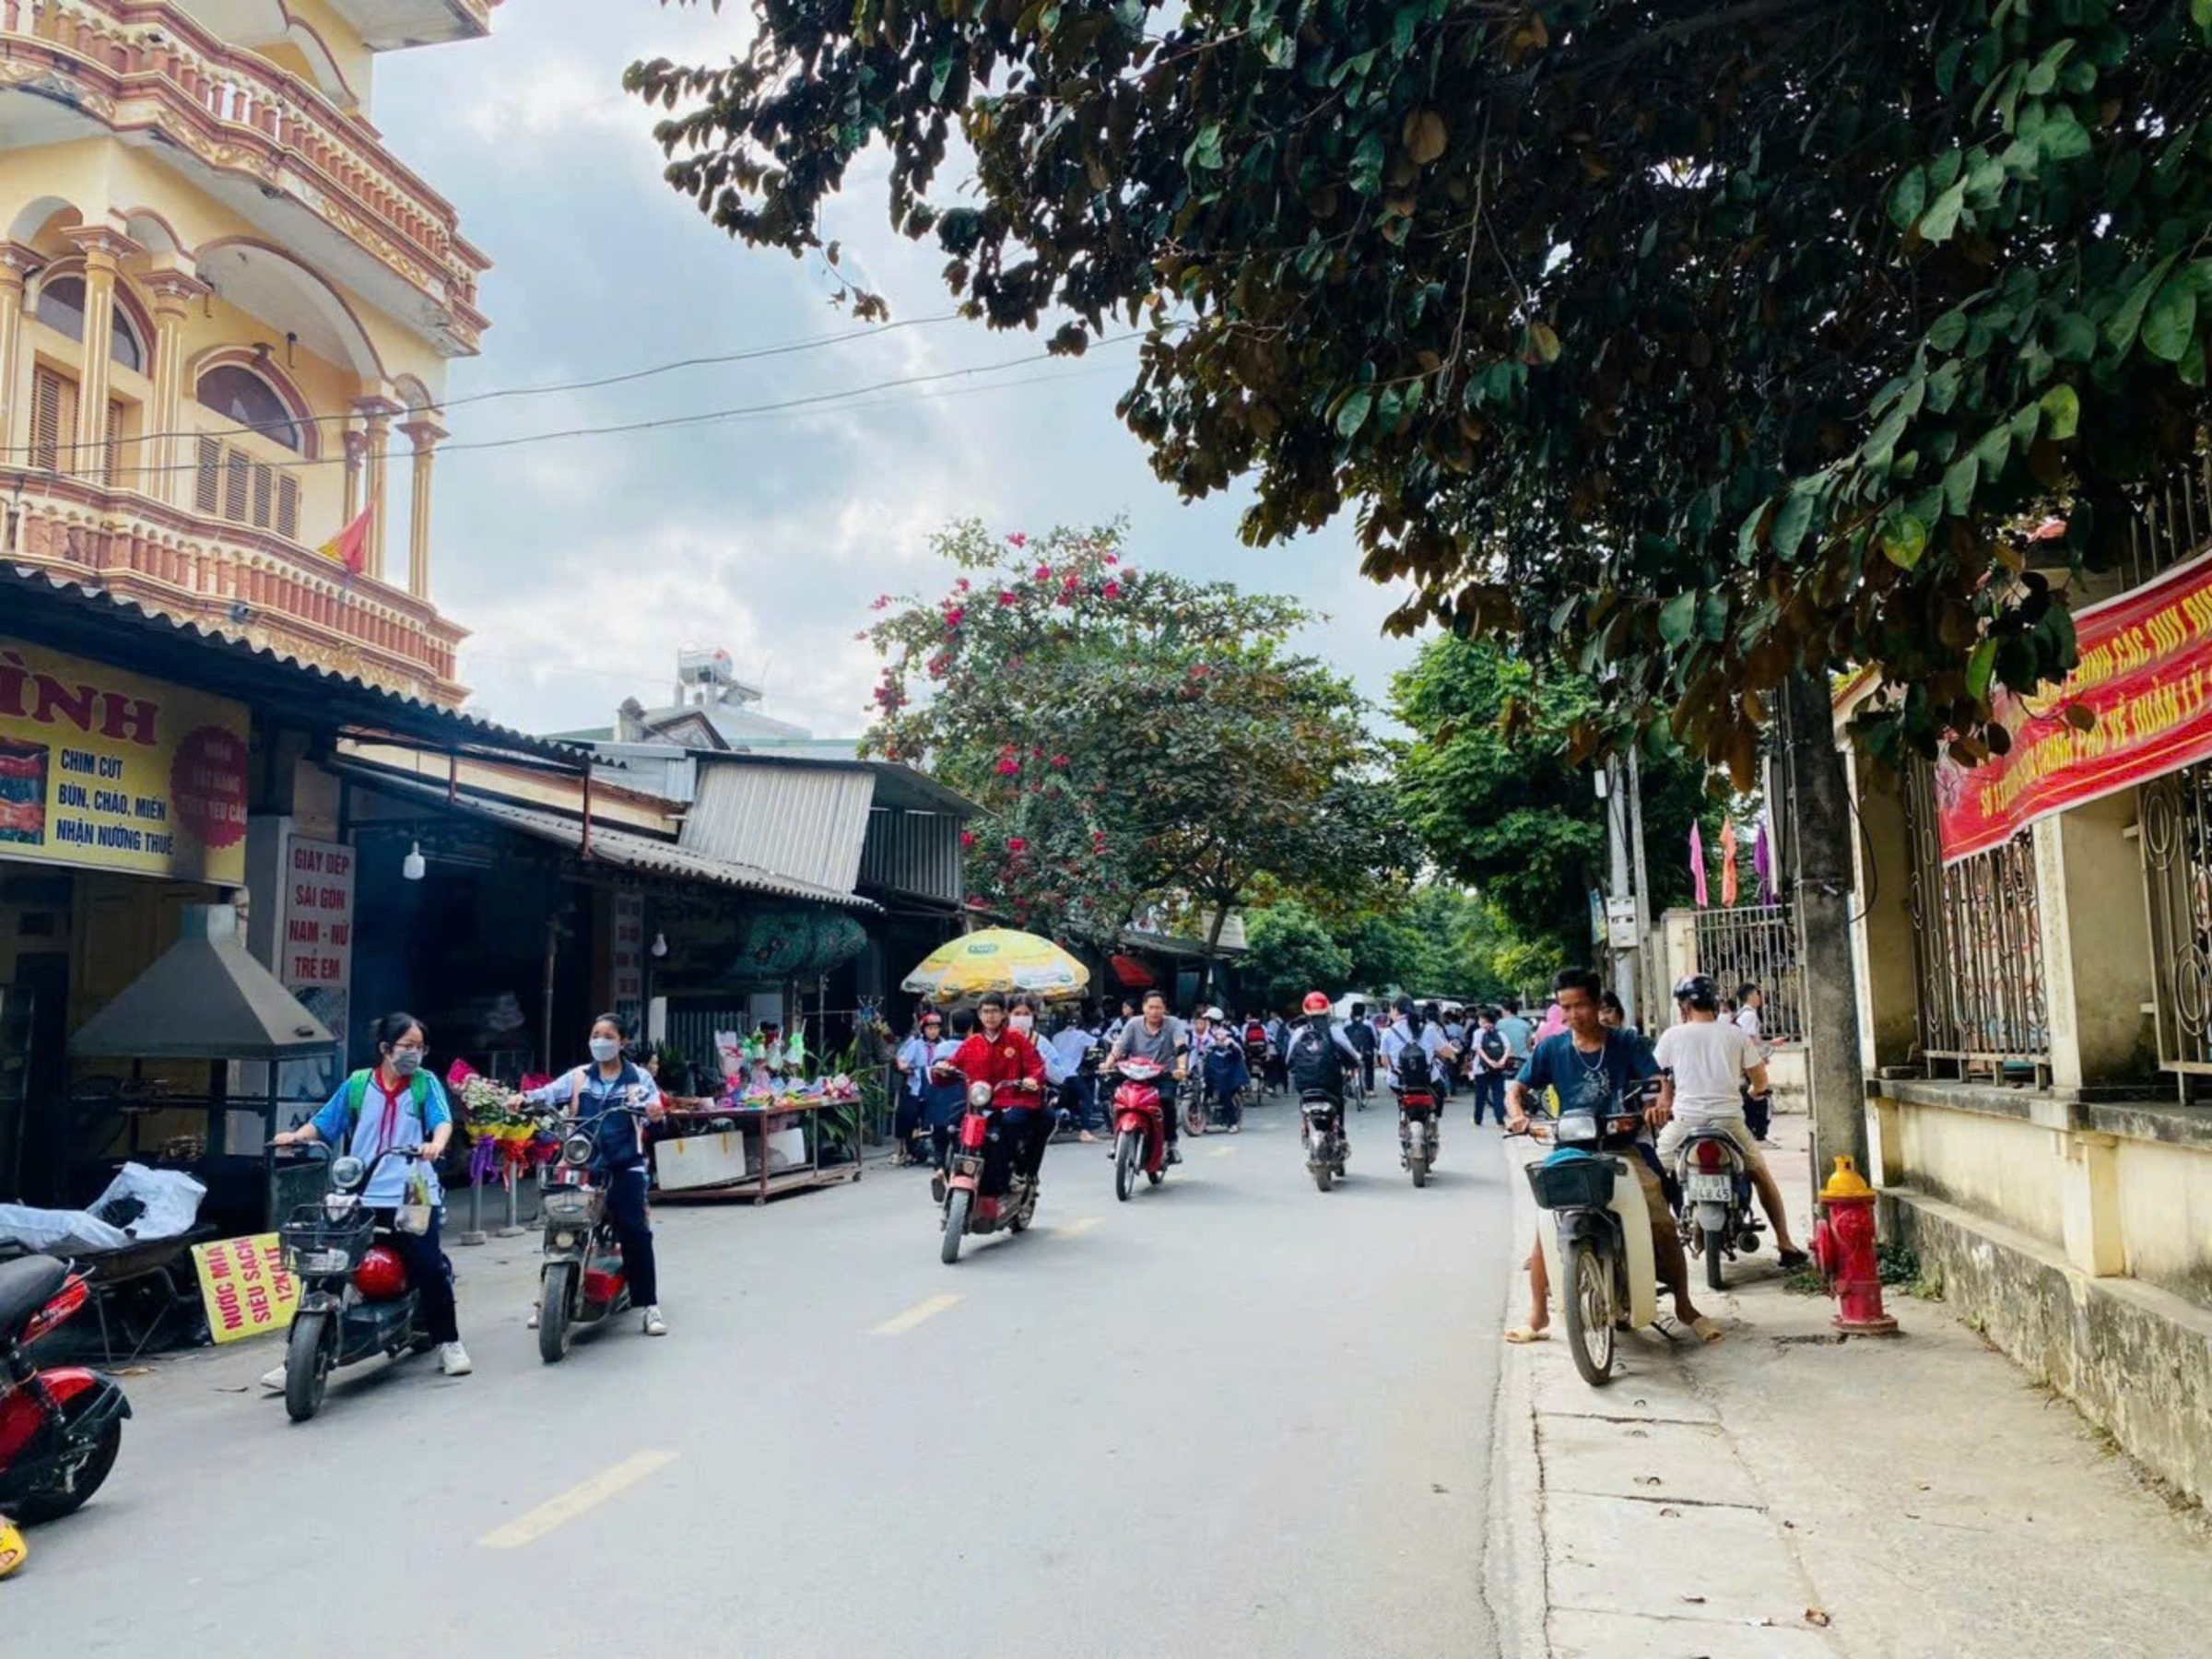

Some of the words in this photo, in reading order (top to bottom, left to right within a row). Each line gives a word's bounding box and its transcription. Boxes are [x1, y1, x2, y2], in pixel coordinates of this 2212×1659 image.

[2112, 626, 2150, 676] CÁC
[2146, 606, 2188, 661] QUY
[61, 748, 95, 775] CHIM
[56, 818, 94, 848] NHẬN
[289, 919, 319, 944] NAM
[321, 956, 340, 980] EM
[215, 1282, 243, 1330] NƯỚC
[246, 1284, 272, 1324] SIÊU
